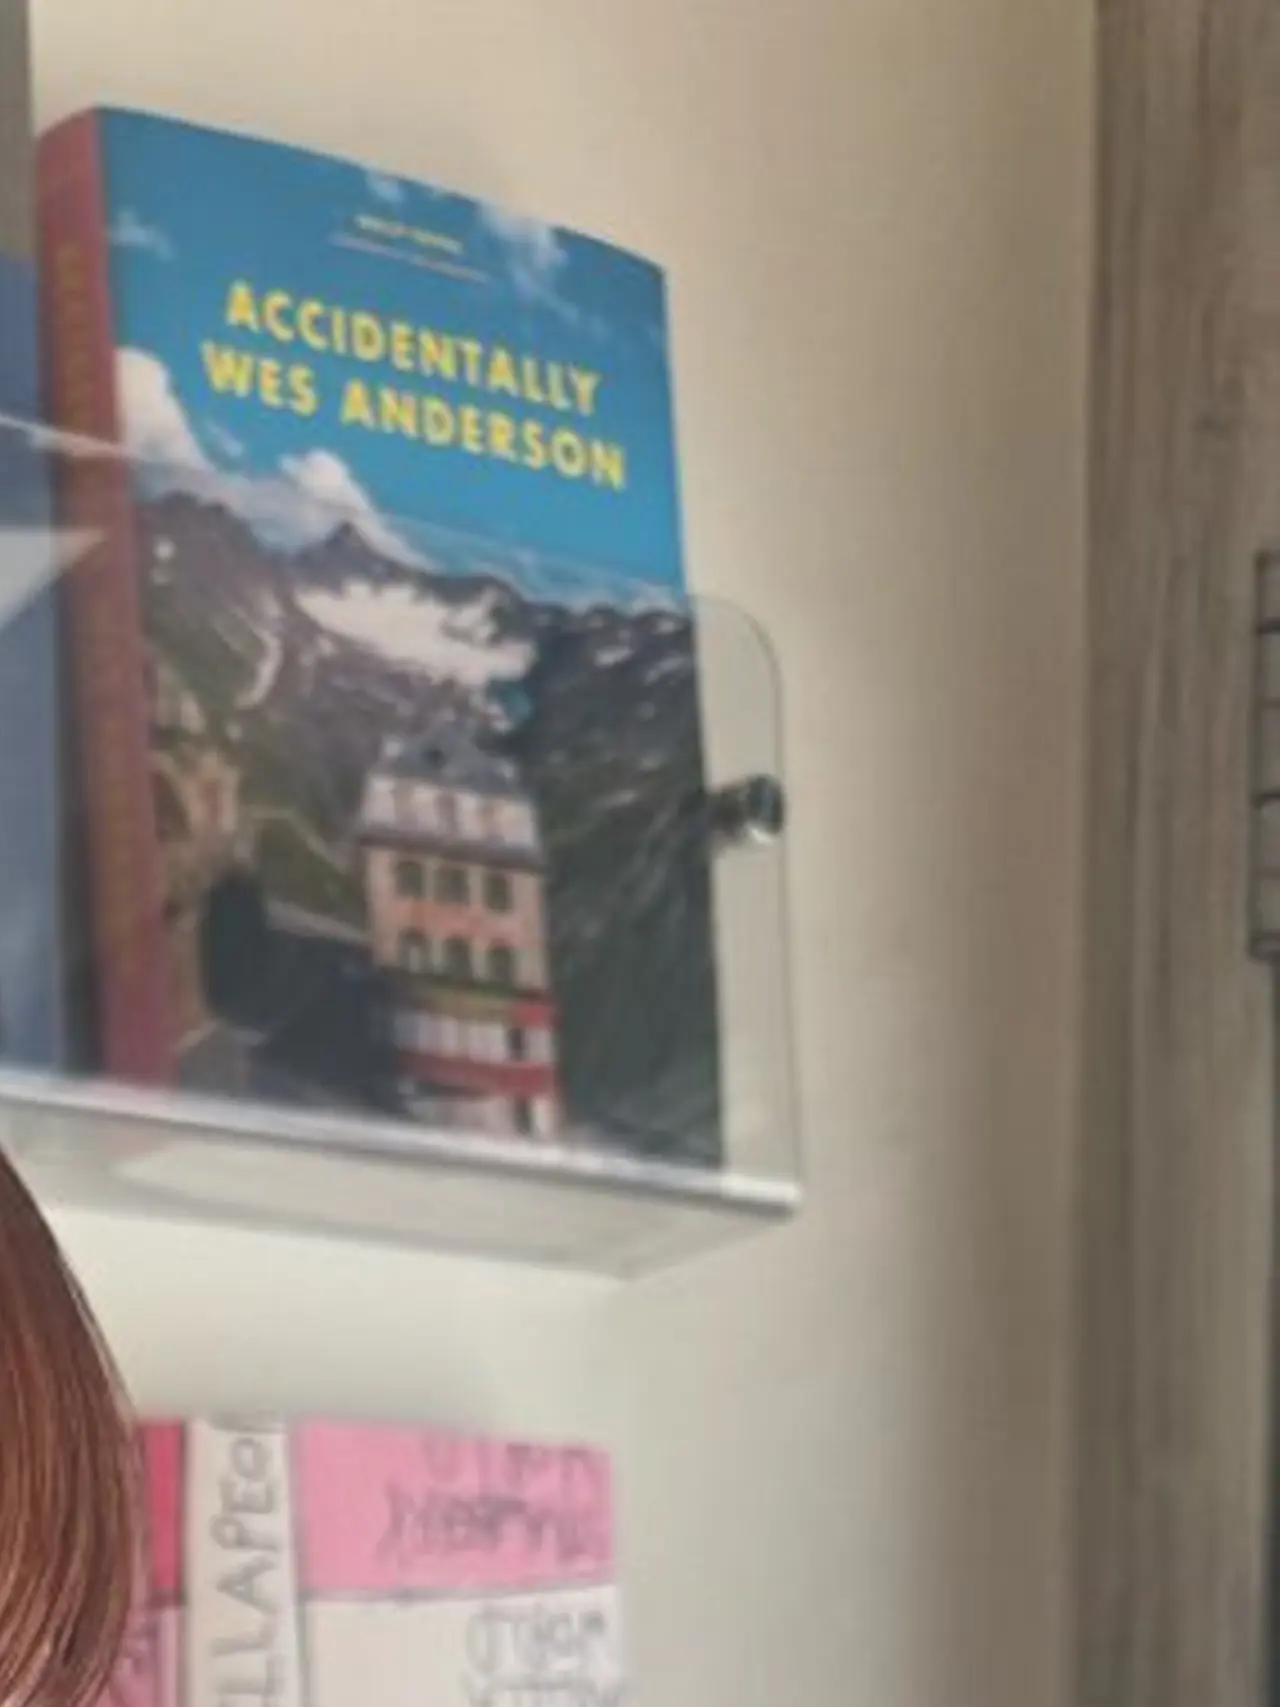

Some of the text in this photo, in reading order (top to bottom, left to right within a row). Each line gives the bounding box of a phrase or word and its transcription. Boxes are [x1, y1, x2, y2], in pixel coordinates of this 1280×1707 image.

[201, 339, 627, 491] WES ANDERSON
[225, 280, 603, 417] ACCIDENTALLY
